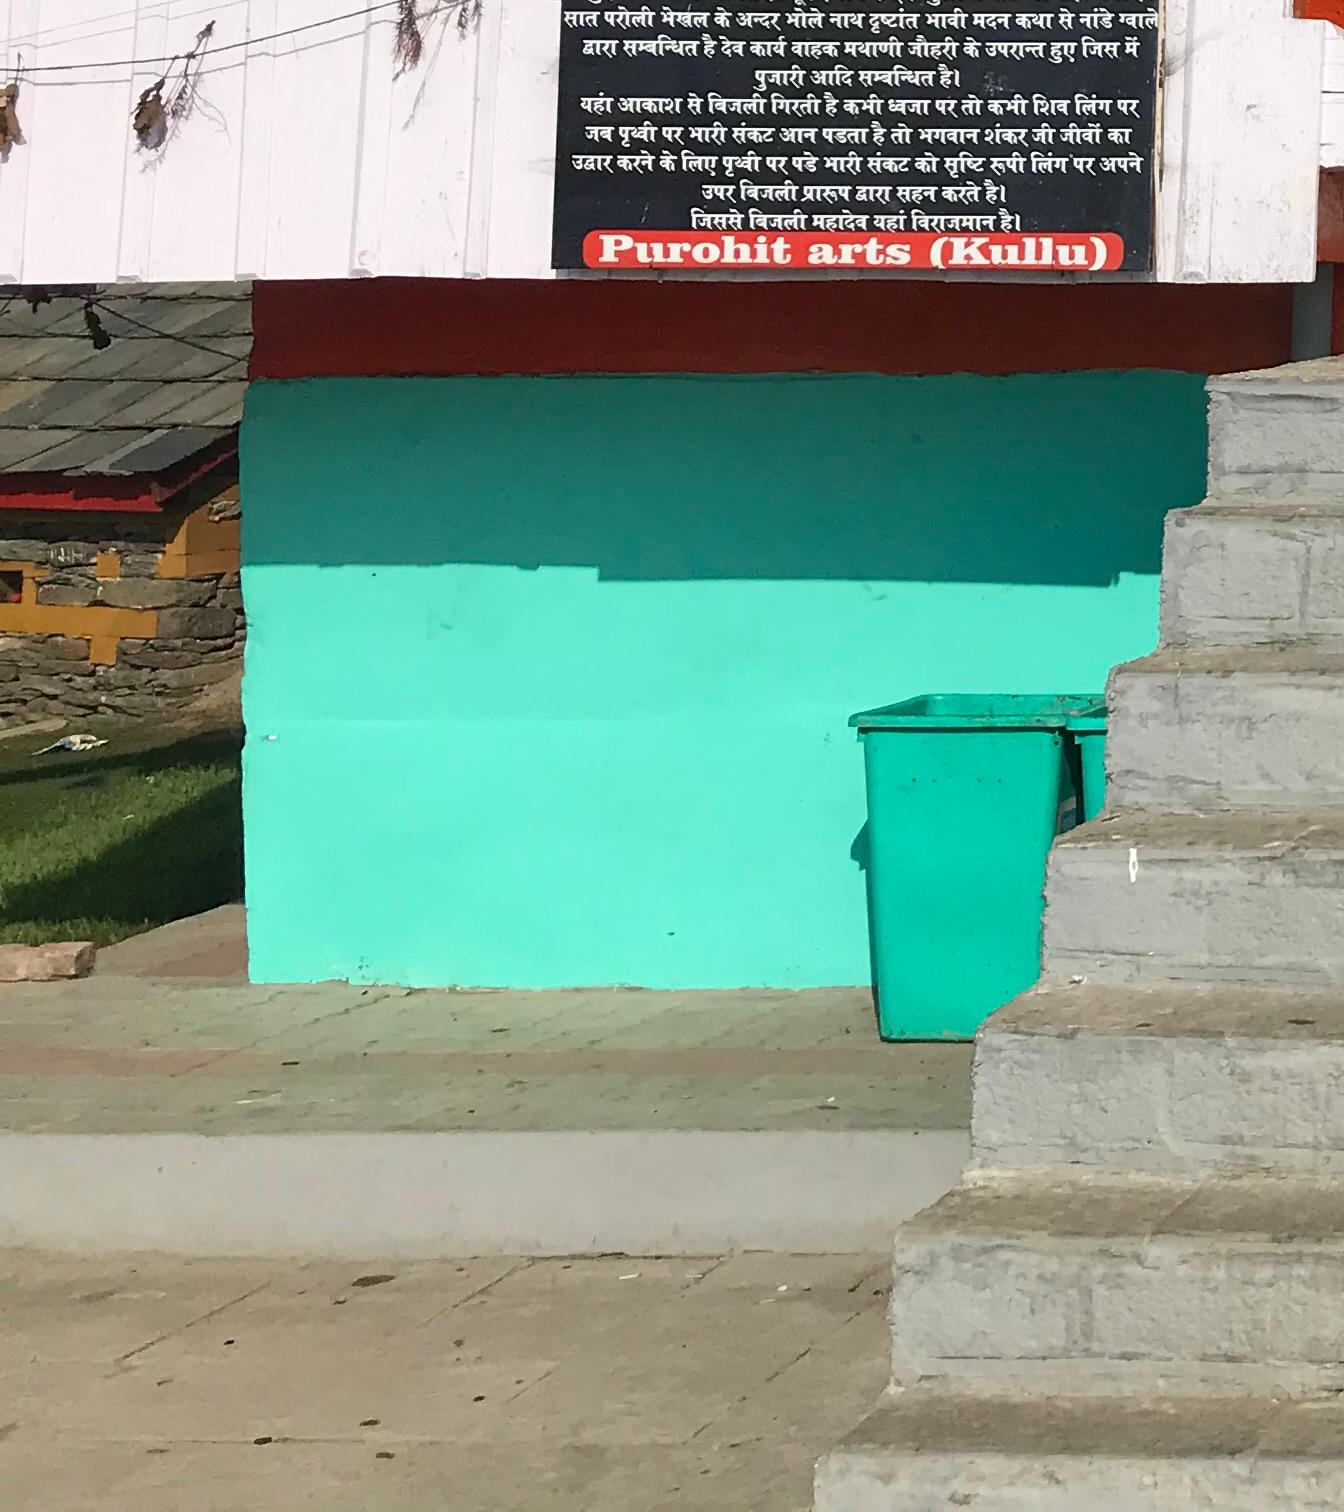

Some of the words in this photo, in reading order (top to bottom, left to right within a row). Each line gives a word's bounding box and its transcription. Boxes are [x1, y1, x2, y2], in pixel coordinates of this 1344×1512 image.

[564, 11, 600, 28] सात
[714, 7, 732, 27] के
[736, 13, 780, 31] अन्दर
[785, 8, 825, 28] भोले
[830, 13, 866, 28] नाथ
[925, 8, 968, 29] भावी
[972, 14, 1012, 30] मदन
[1016, 14, 1054, 29] कथा
[1058, 8, 1075, 30] से
[583, 40, 619, 58] द्वारा
[623, 34, 700, 57] सम्बन्धित
[702, 34, 717, 58] है
[721, 36, 746, 57] देव
[750, 36, 787, 57] कार्य
[792, 42, 840, 59] वाहक
[908, 35, 960, 60] जौहरी
[963, 37, 982, 58] के
[986, 42, 1046, 60] उपरान्त
[1050, 42, 1078, 63] हुए
[1081, 36, 1121, 58] जिस
[1125, 36, 1140, 57] में
[580, 92, 614, 115] यहां
[618, 98, 683, 114] आकाश
[687, 93, 704, 115] से
[708, 92, 767, 114] बिजली
[771, 93, 822, 117] गिरती
[824, 92, 839, 116] है
[843, 94, 884, 115] कभी
[888, 99, 931, 115] ध्वजा
[936, 100, 958, 118] पर
[962, 94, 984, 115] तो
[988, 93, 1029, 115] कभी
[1032, 94, 1071, 116] शिव
[1075, 94, 1113, 115] लिंग
[1117, 100, 1139, 118] पर
[585, 126, 615, 142] जब
[619, 121, 658, 147] पृथ्वी
[662, 127, 684, 145] पर
[688, 122, 728, 145] भारी
[732, 122, 776, 144] संकट
[779, 128, 818, 144] आन
[822, 128, 869, 144] पडता
[871, 121, 887, 146] है
[891, 123, 913, 144] तो
[918, 129, 980, 144] भगवान
[985, 123, 1028, 147] शंकर
[1032, 123, 1056, 144] जी
[1060, 123, 1103, 144] जीवों
[1108, 129, 1132, 144] का
[617, 150, 656, 174] करने
[660, 150, 678, 171] के
[682, 150, 718, 176] लिए
[723, 151, 762, 177] पृथ्वी
[766, 157, 788, 175] पर
[792, 151, 819, 172] पडे
[824, 151, 863, 175] भारी
[867, 152, 911, 174] संकट
[915, 152, 940, 173] को
[944, 152, 986, 178] सृष्टि
[990, 152, 1027, 176] रूपी
[1030, 152, 1069, 173] लिंग
[1074, 157, 1095, 176] पर
[1100, 152, 1144, 173] अपने
[691, 208, 744, 230] जिससे
[749, 208, 808, 230] बिजली
[812, 210, 870, 232] महादेव
[874, 210, 907, 233] यहां
[911, 209, 996, 233] विराजमान
[998, 208, 1020, 233] है।
[598, 234, 792, 265] Purohit
[807, 237, 911, 265] arts
[930, 236, 1108, 270] (Kullu)
